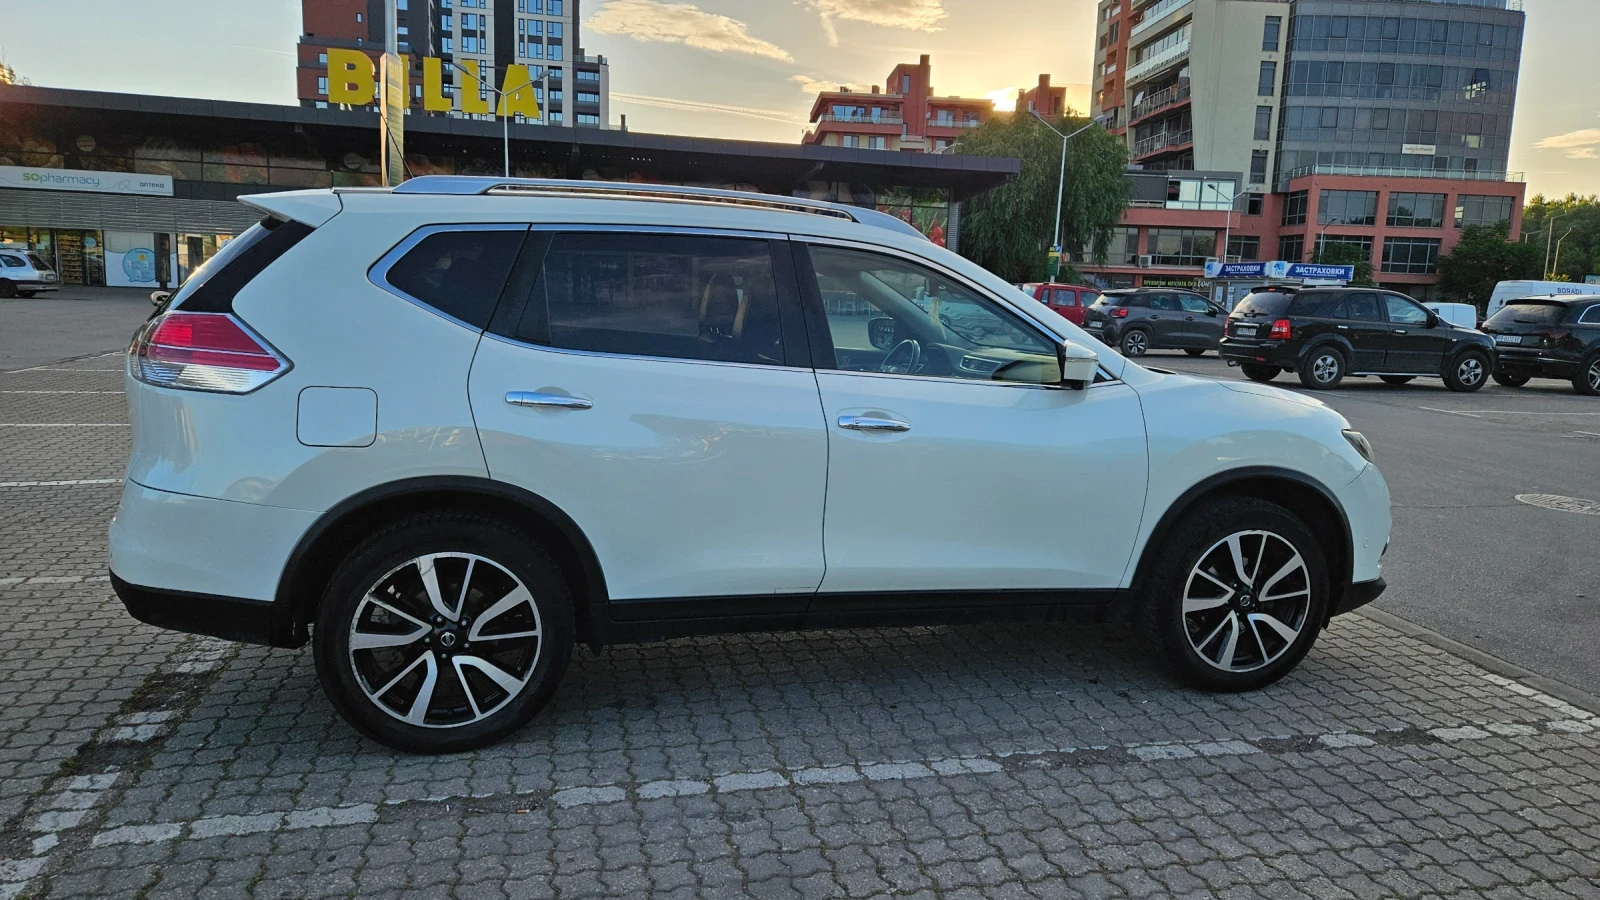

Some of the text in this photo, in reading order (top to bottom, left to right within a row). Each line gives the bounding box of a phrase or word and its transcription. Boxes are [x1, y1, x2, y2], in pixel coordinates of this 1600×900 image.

[23, 172, 100, 187] sopharmacy
[139, 181, 165, 189] аптека
[1295, 266, 1345, 275] ЗАСТРАХОВКИ
